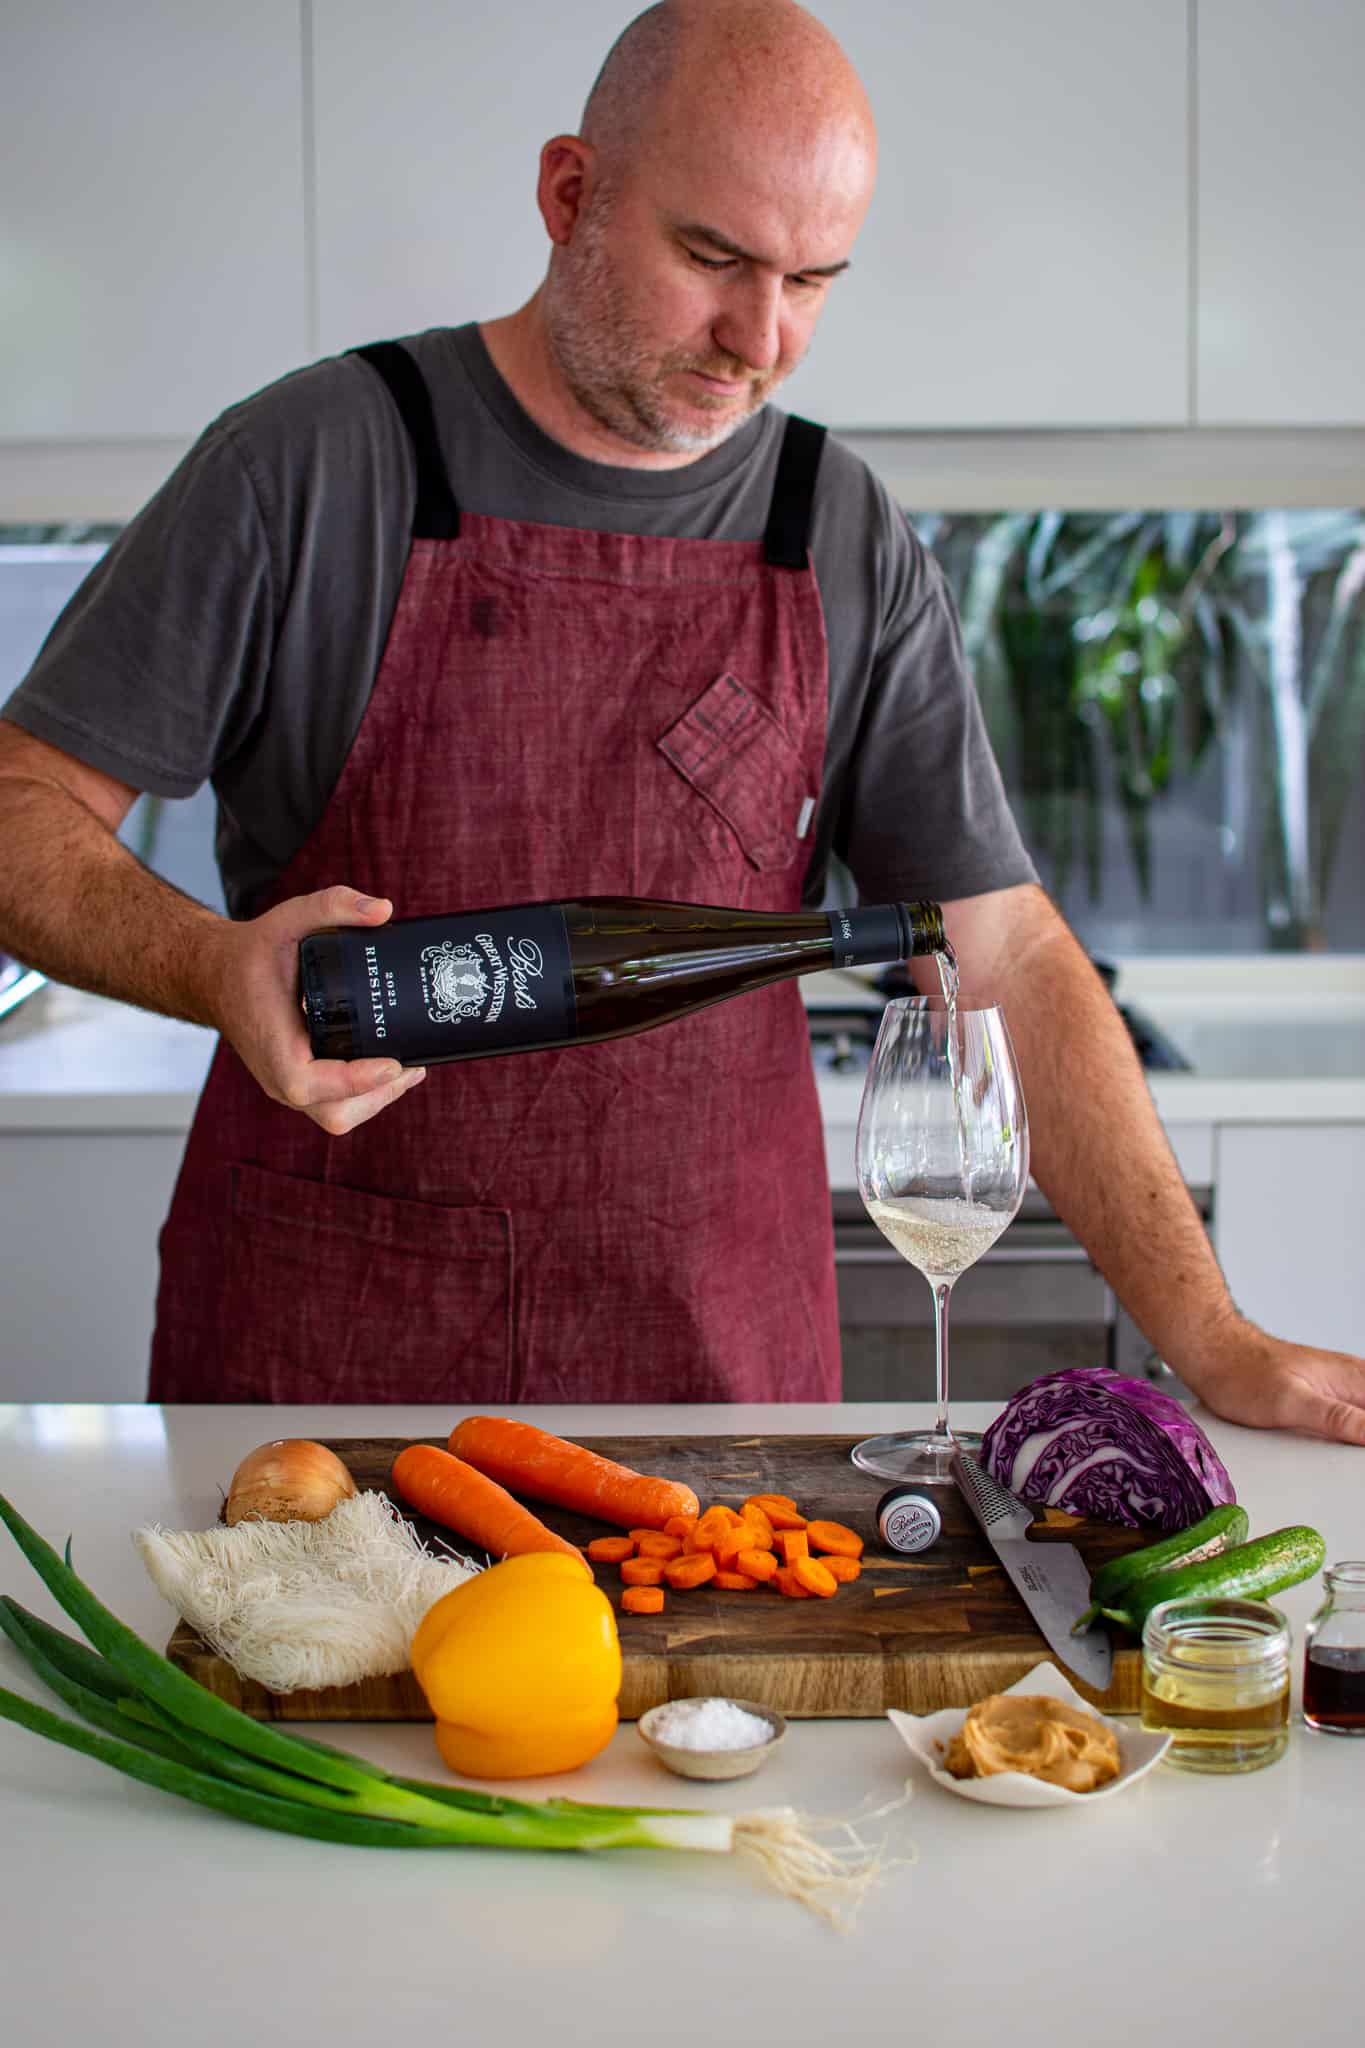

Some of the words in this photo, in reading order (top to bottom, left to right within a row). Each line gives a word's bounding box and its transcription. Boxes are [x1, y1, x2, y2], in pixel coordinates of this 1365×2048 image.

[475, 933, 502, 967] GREAT
[840, 919, 853, 939] 1866
[365, 945, 387, 1039] RIESLING
[384, 971, 397, 1007] 2023
[484, 965, 509, 1023] WESTERN
[507, 936, 543, 1010] Best's
